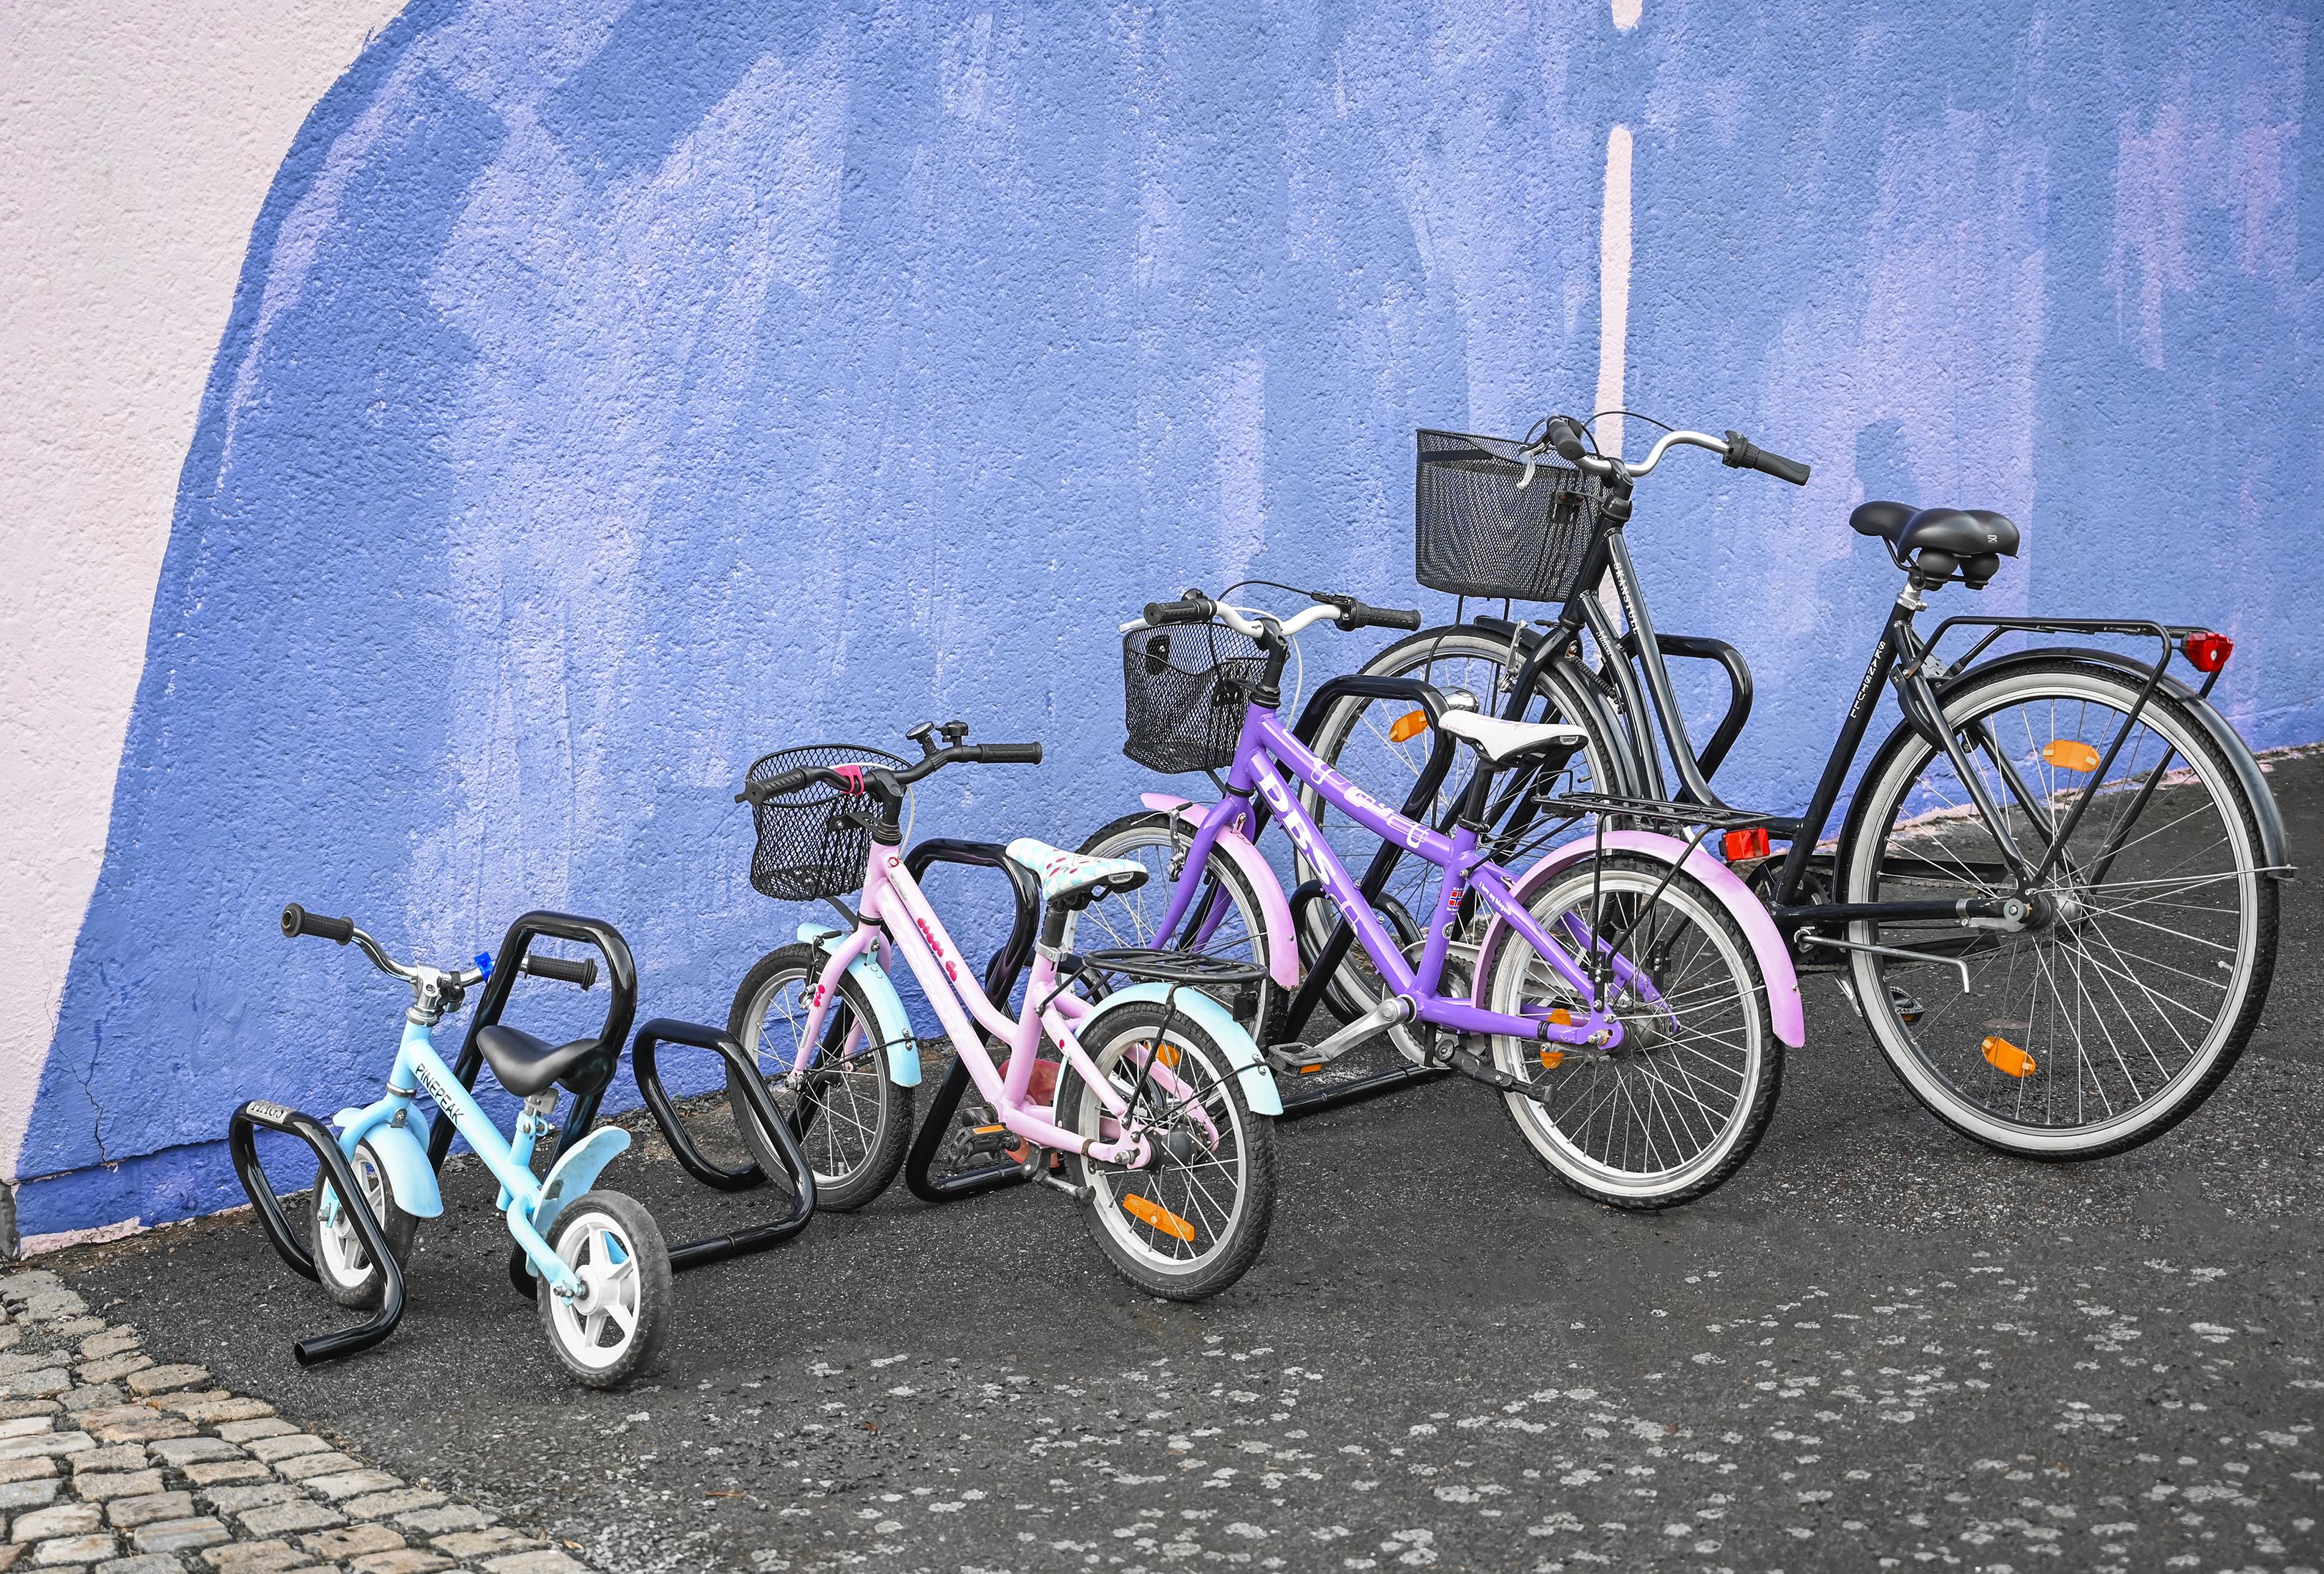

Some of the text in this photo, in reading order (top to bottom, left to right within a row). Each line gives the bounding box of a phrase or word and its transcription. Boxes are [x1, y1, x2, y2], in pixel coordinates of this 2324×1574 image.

[1613, 562, 1640, 635] SKANSTULL
[1850, 640, 1886, 718] SKANSTULL
[1258, 771, 1337, 885] DBS
[882, 901, 972, 1049] Crescent
[251, 1102, 285, 1118] HAGS
[415, 1062, 464, 1126] PINEPEAK
